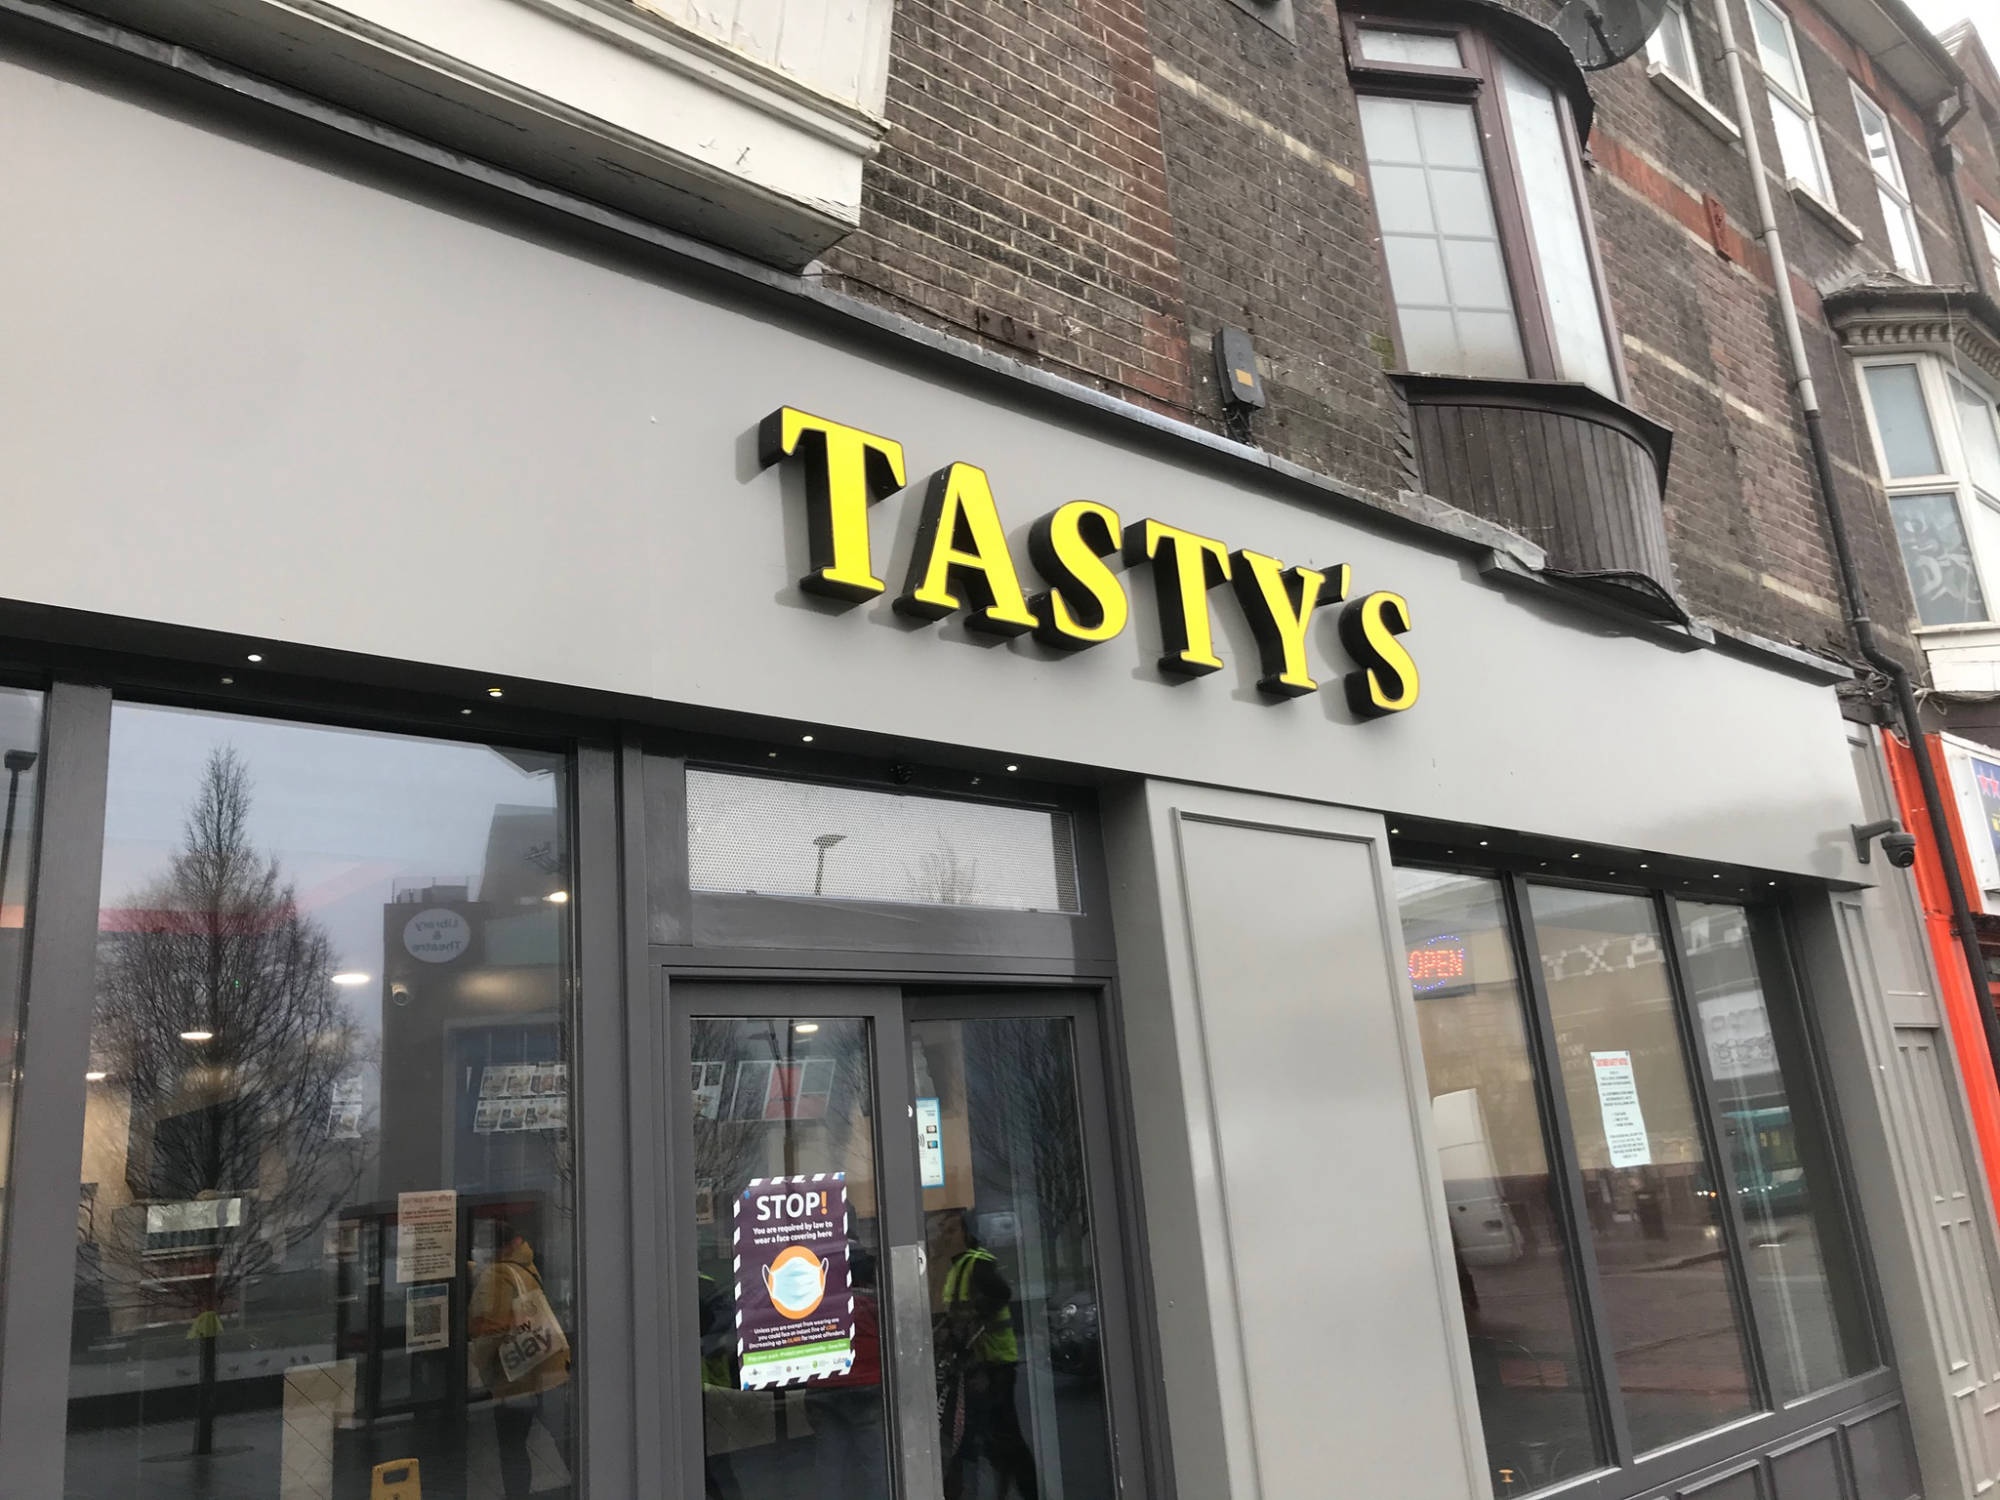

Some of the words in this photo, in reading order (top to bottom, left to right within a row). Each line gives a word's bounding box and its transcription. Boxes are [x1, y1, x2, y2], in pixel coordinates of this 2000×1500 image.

[762, 405, 1419, 717] TASTY'S
[1408, 949, 1464, 979] OPEN
[757, 1191, 827, 1220] STOP!
[778, 1223, 803, 1233] required
[804, 1222, 812, 1230] by
[791, 1232, 816, 1240] covering
